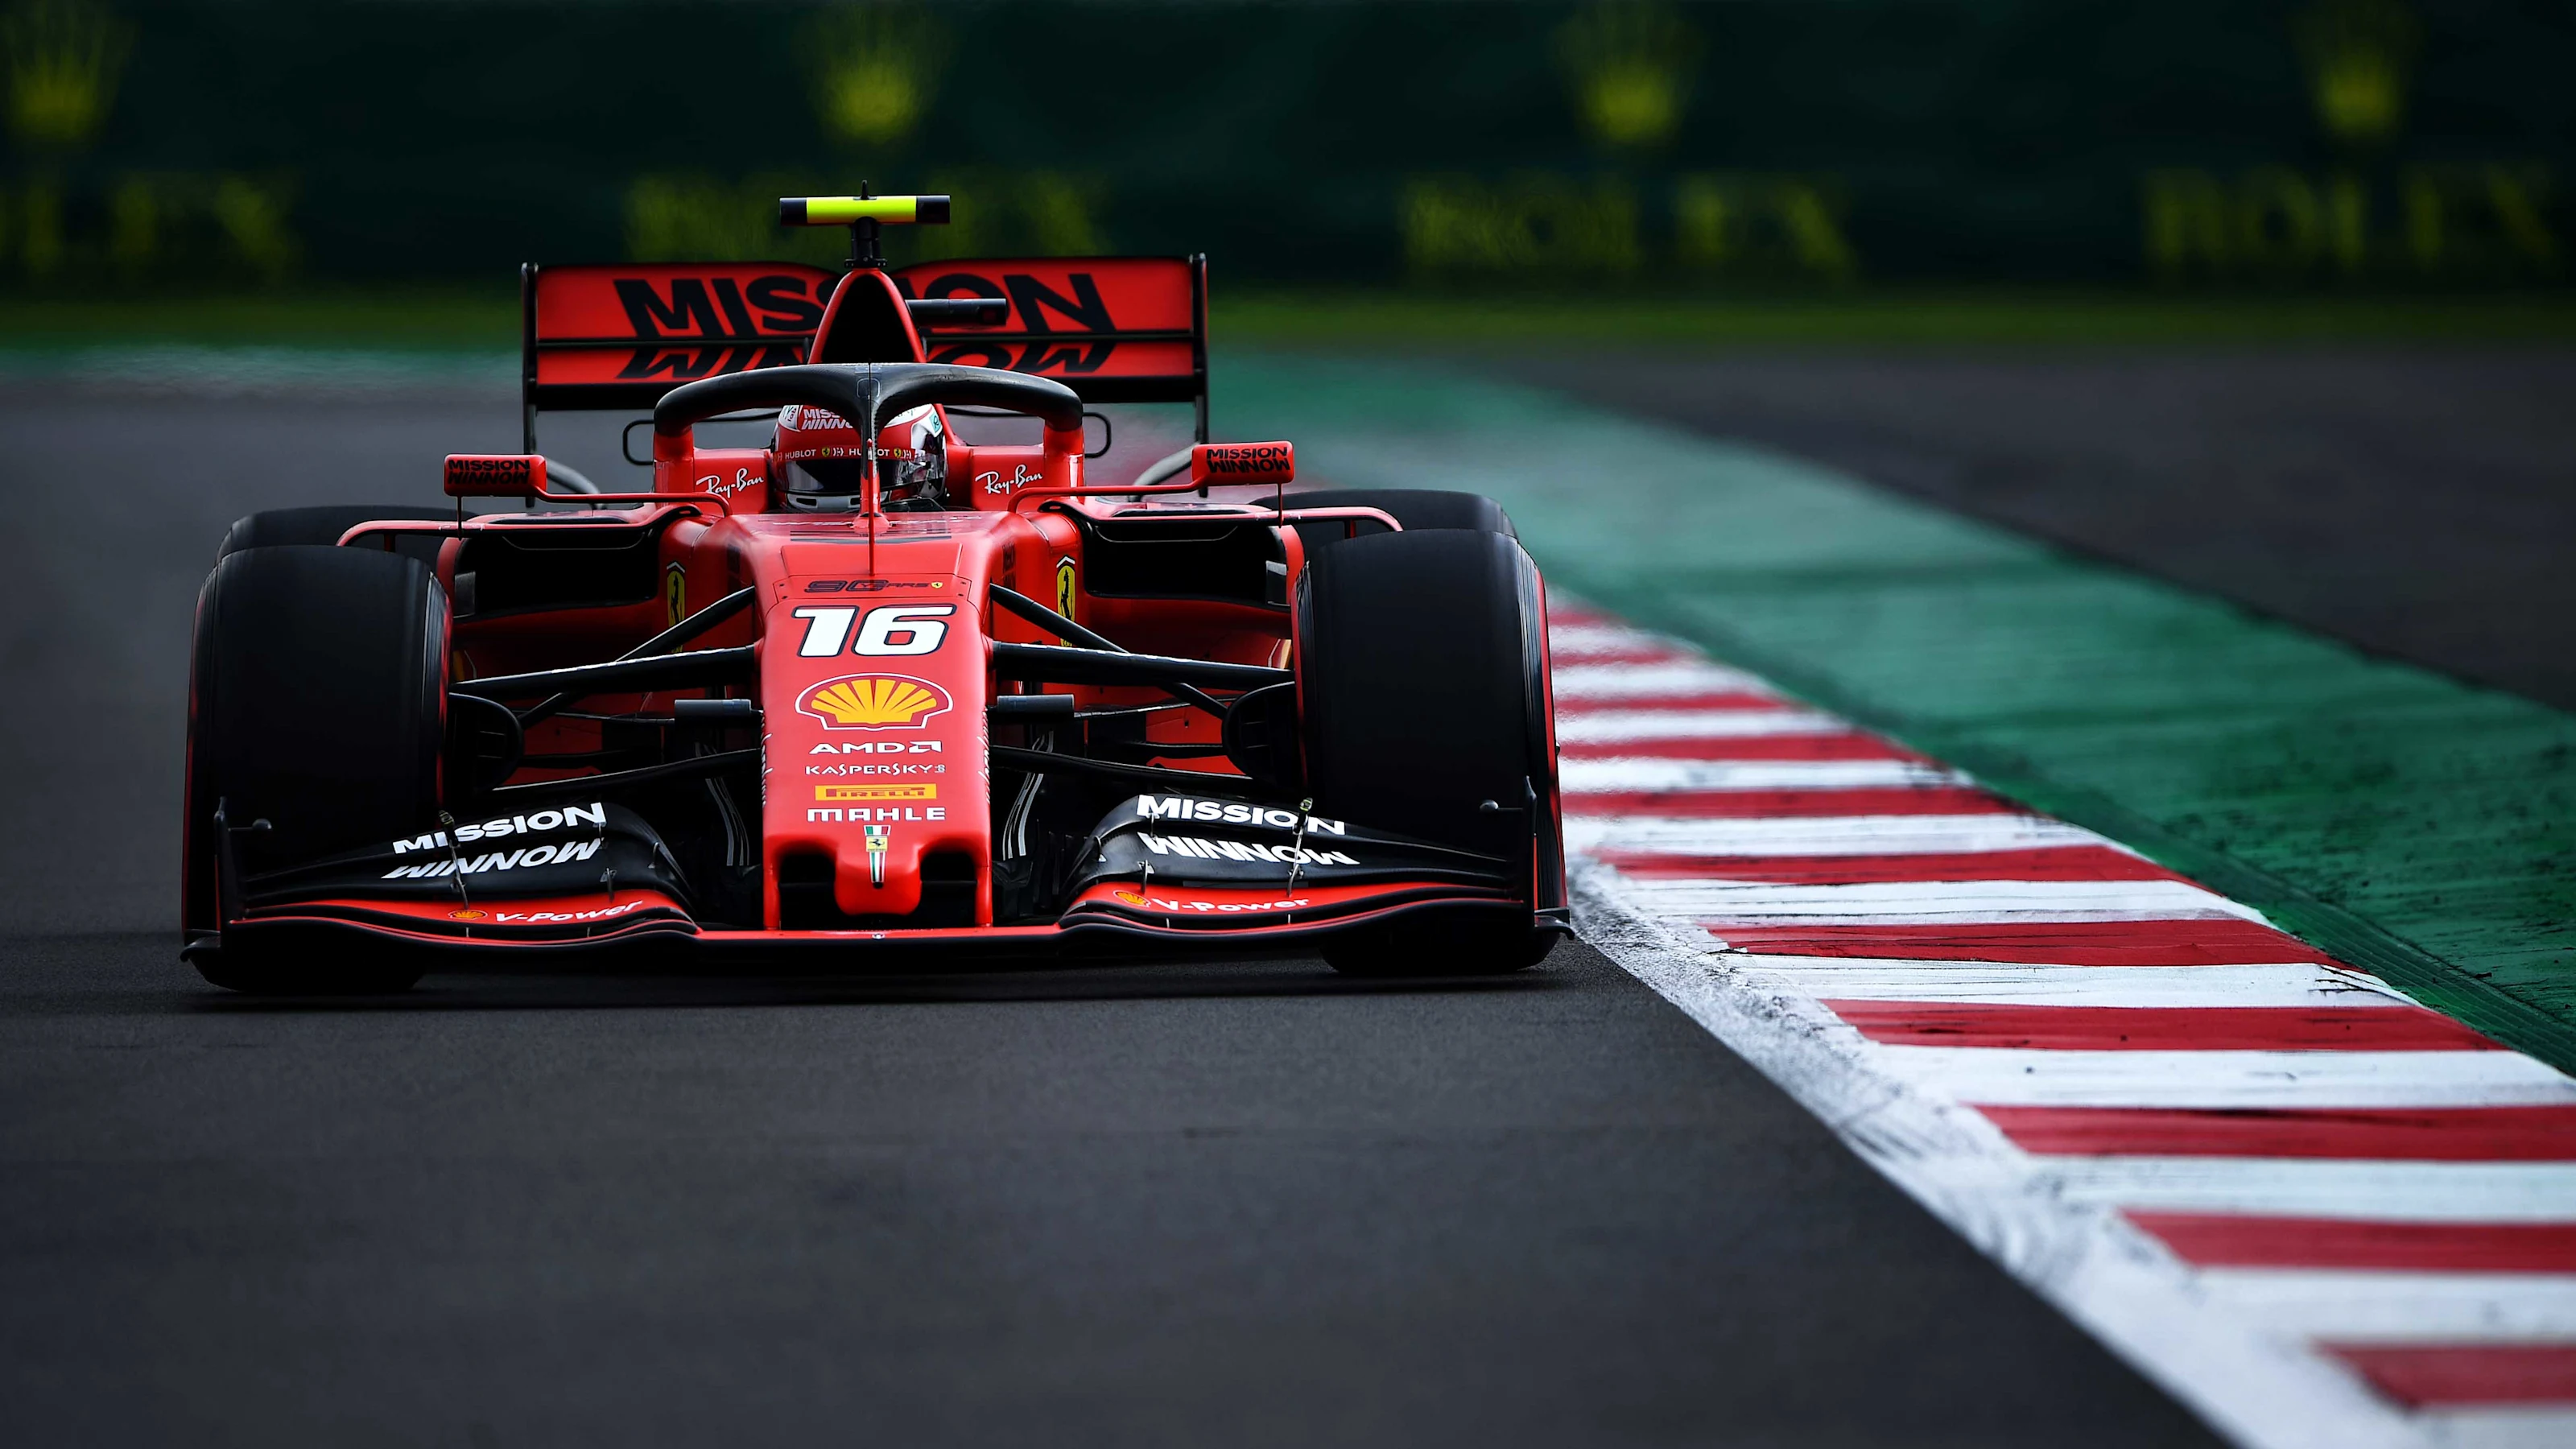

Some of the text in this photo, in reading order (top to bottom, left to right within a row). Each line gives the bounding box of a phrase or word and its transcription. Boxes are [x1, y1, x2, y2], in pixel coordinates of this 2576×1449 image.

[785, 448, 890, 460] HUBLOT HUOT
[1207, 448, 1288, 460] MISSION
[448, 460, 530, 471] MISSION
[1208, 458, 1290, 473] WINNOW
[448, 470, 529, 484] WINNOW
[696, 468, 764, 498] Ray-Ban
[975, 464, 1043, 495] Ray-Ban
[791, 603, 957, 658] 16
[808, 741, 906, 755] AMD
[805, 762, 934, 777] KASPERSKY
[825, 786, 926, 798] PIRELLI
[807, 807, 946, 822] MAHLE
[1136, 794, 1346, 836] MISSION
[392, 802, 608, 855] MISSION
[1137, 832, 1360, 865] WINNOW
[380, 836, 606, 879] WINNOW
[495, 900, 643, 923] V-Power
[1151, 897, 1310, 912] V-Power
